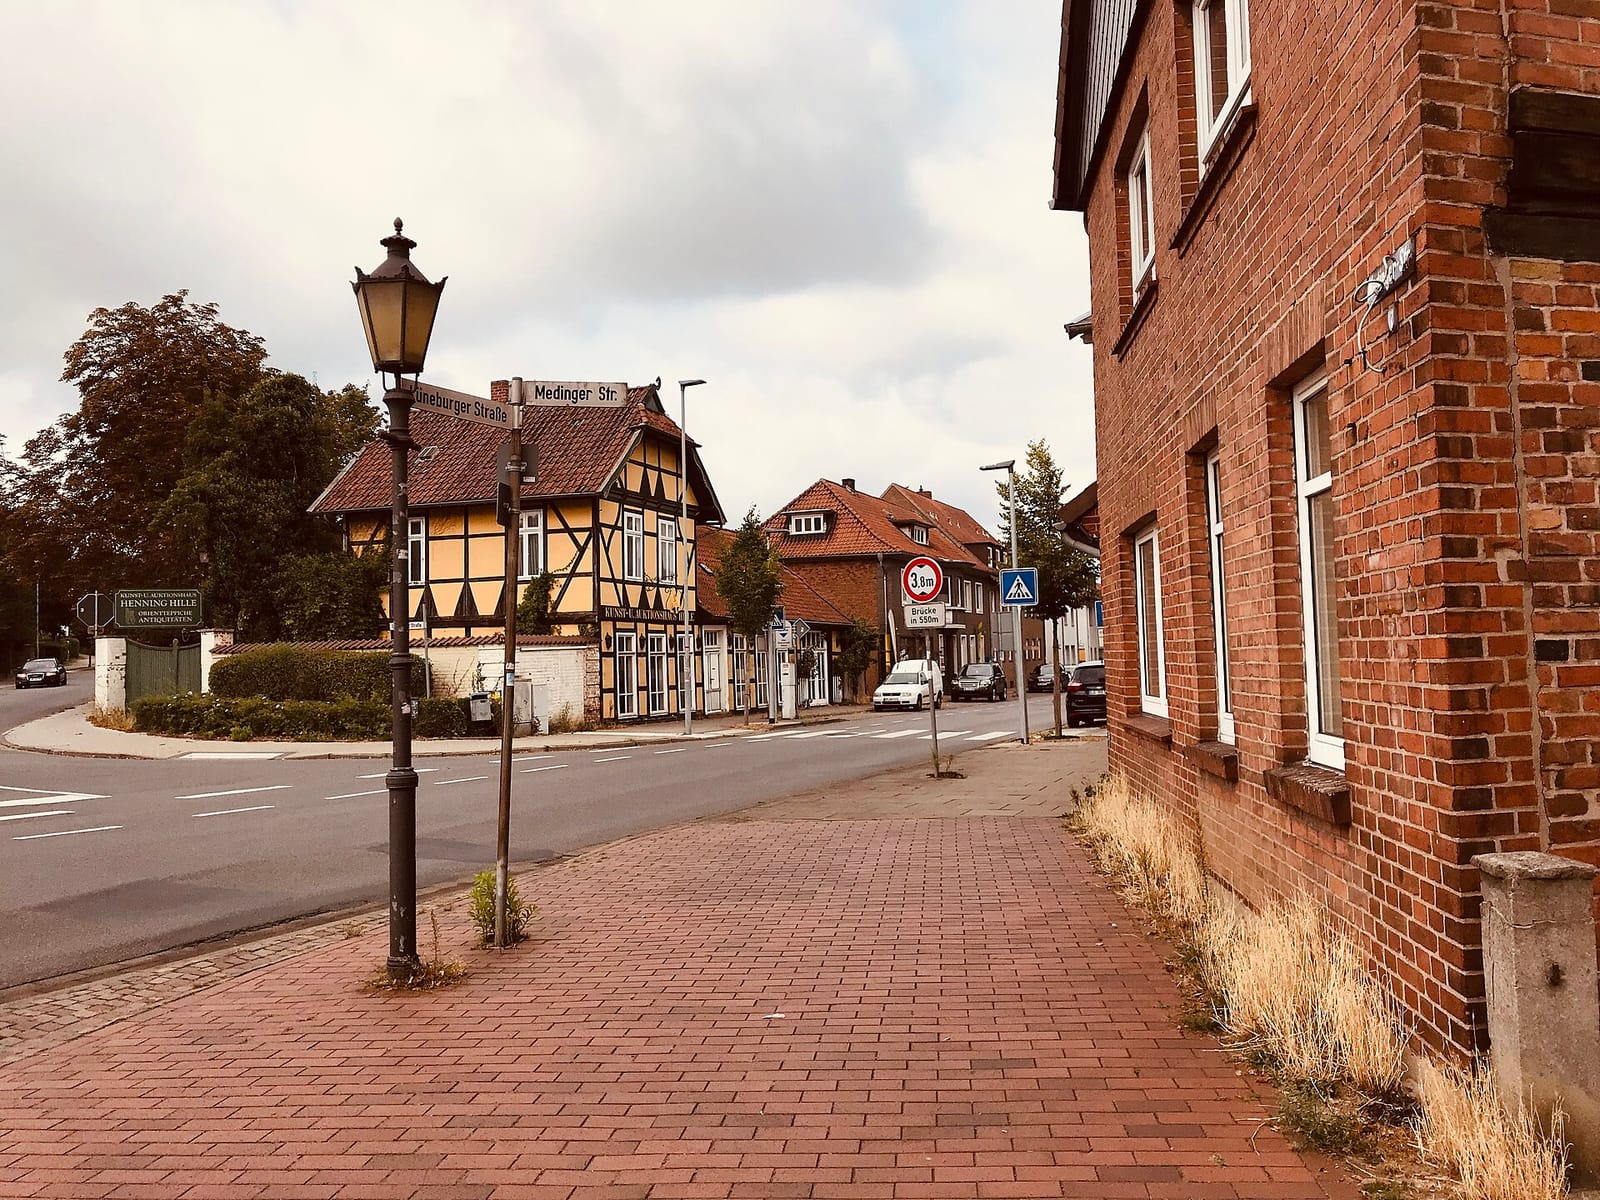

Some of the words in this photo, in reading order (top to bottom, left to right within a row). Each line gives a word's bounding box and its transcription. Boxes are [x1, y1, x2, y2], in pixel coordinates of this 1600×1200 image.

[534, 385, 593, 404] Medinger
[598, 386, 617, 401] Str.
[474, 401, 507, 423] Straße
[120, 599, 168, 608] HENNING
[169, 599, 197, 607] HILLE
[911, 606, 937, 615] Brücke
[910, 617, 918, 625] in
[919, 616, 939, 624] 550m
